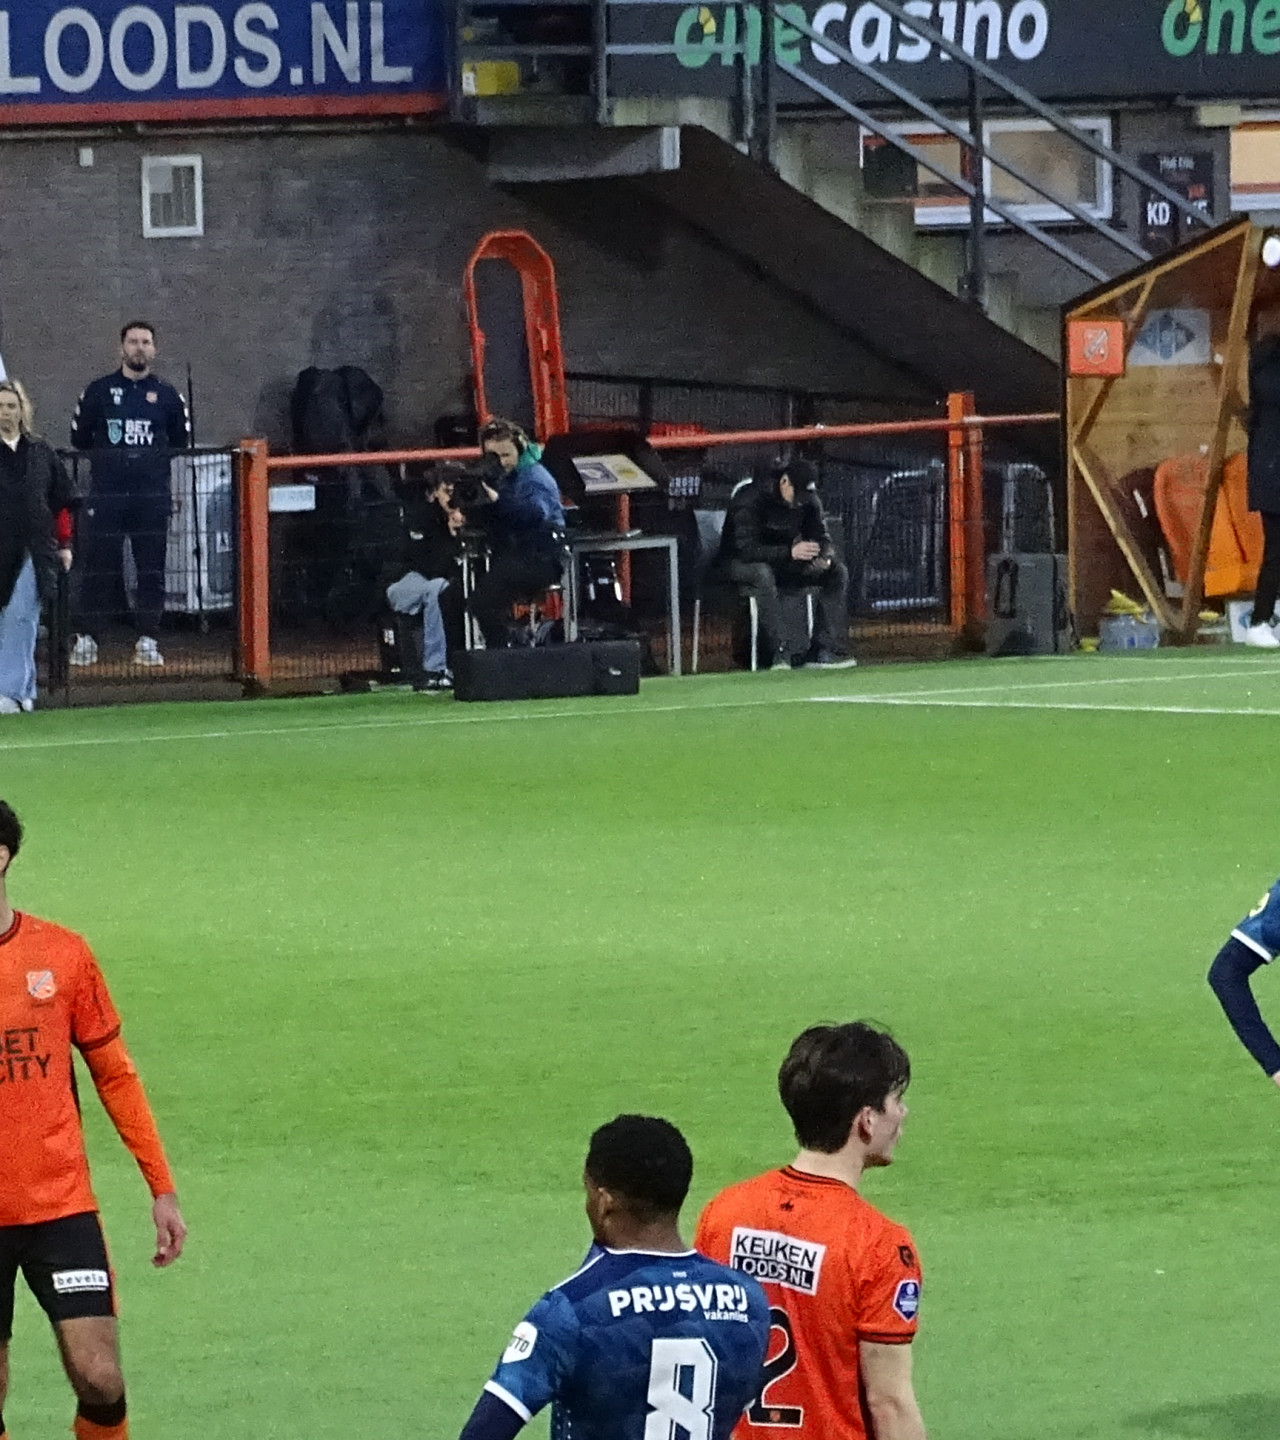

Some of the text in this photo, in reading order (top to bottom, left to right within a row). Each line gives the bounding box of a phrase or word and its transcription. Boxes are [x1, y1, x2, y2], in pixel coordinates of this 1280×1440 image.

[125, 419, 151, 433] BET
[125, 432, 153, 445] CITY
[735, 1233, 817, 1269] KEUKEN
